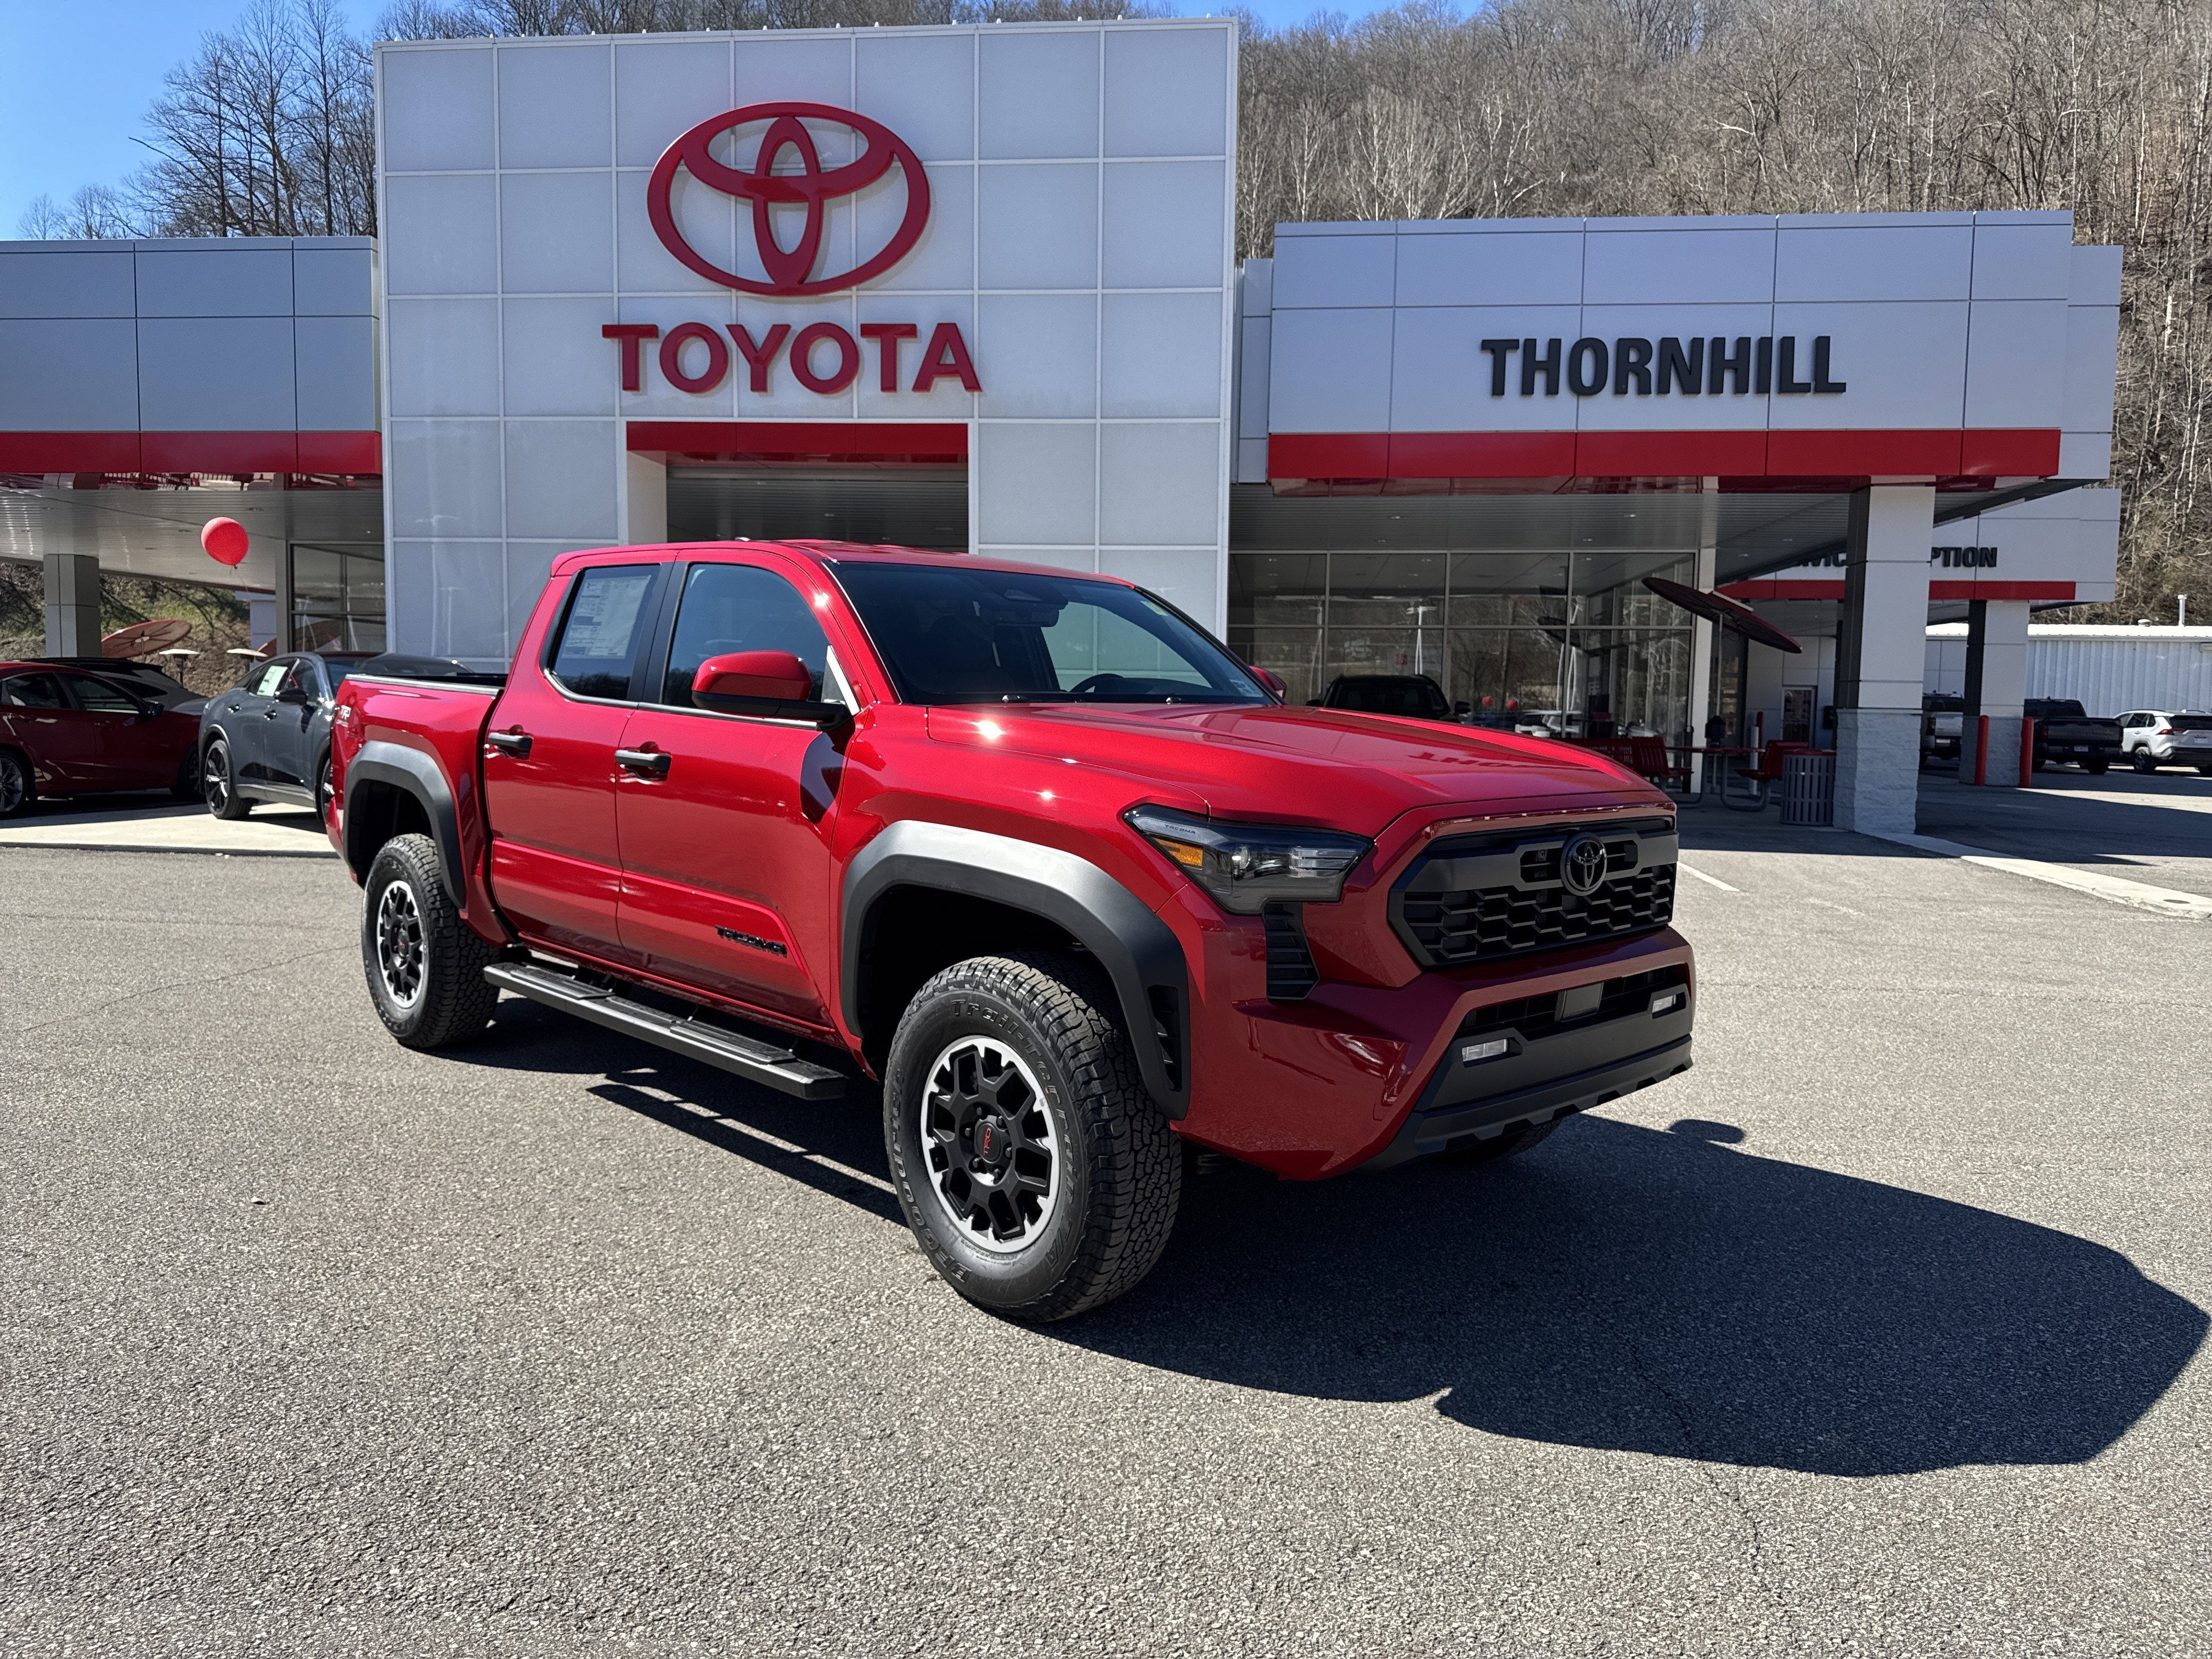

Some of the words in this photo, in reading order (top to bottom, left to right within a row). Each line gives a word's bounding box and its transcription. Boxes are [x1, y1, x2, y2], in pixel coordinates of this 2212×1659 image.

[602, 321, 983, 394] TOYOTA
[1481, 335, 1847, 396] THORNHILL
[1931, 546, 1997, 567] PTION
[1165, 825, 1195, 834] TACOMA
[983, 1127, 992, 1156] TRD
